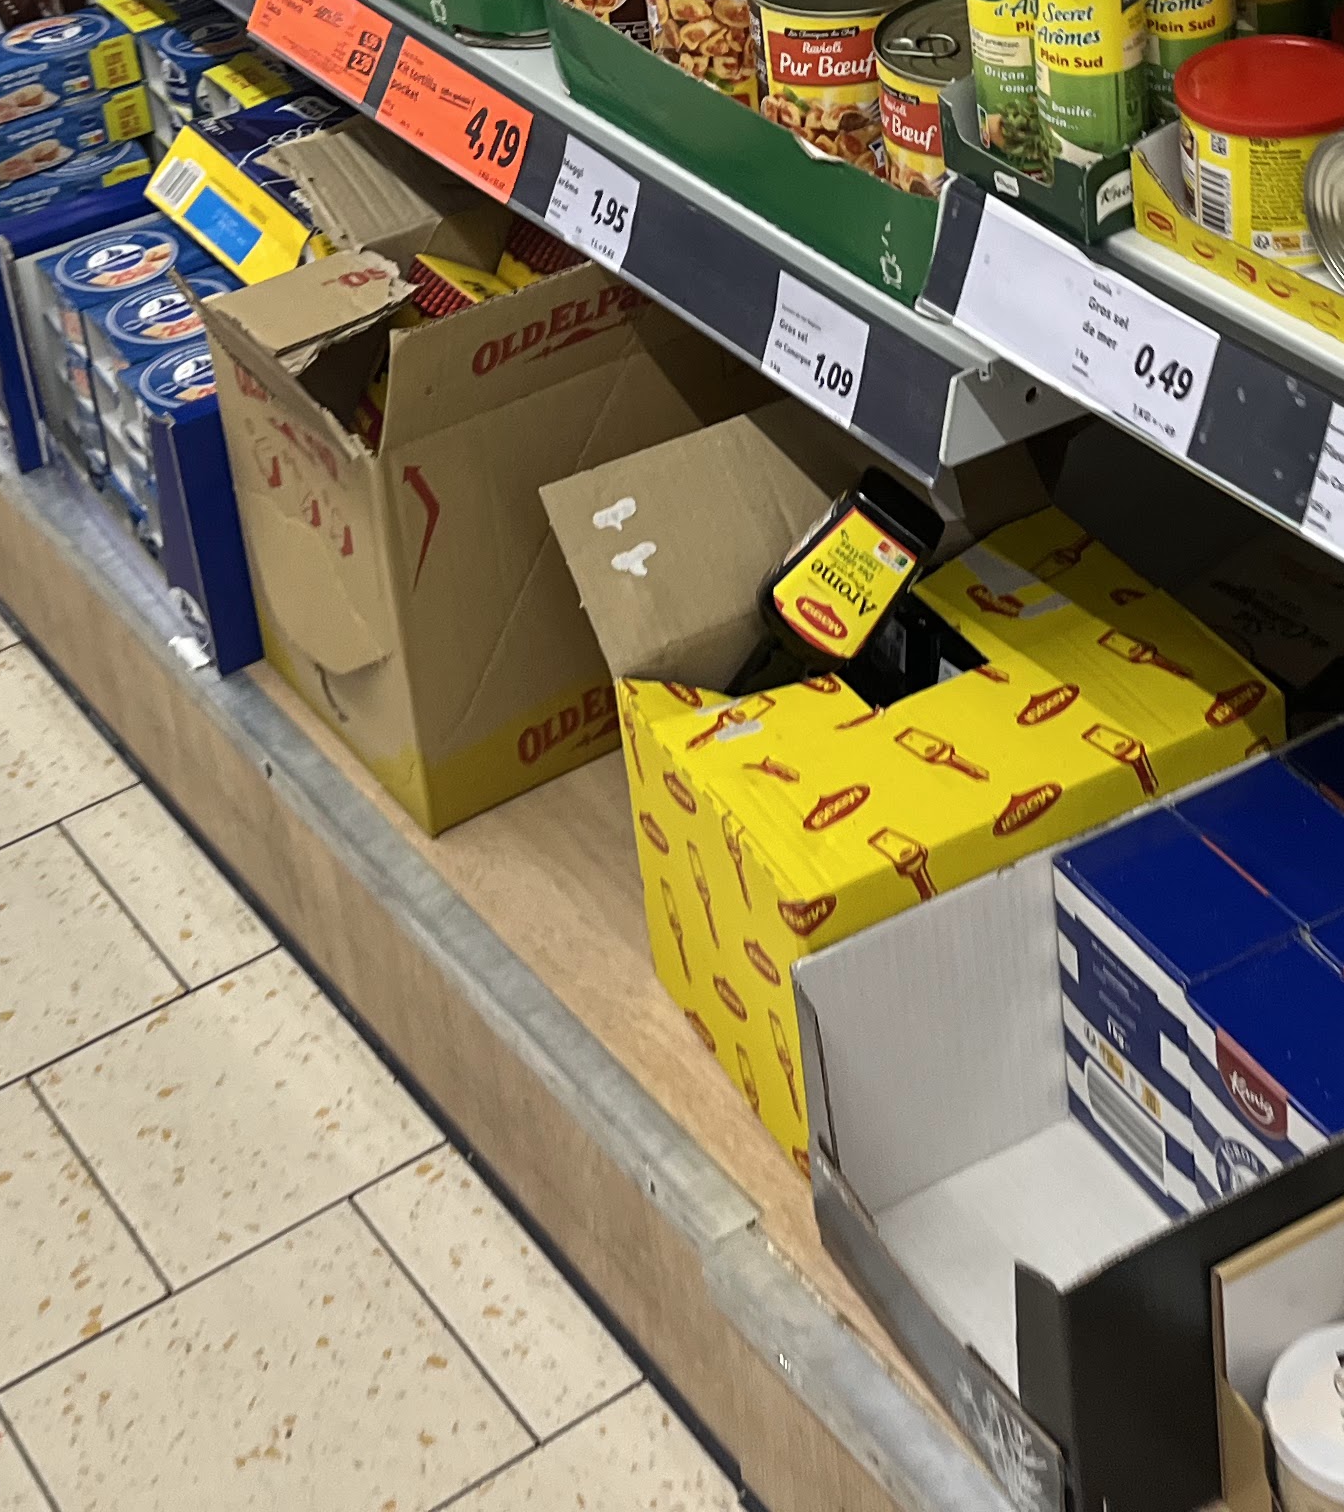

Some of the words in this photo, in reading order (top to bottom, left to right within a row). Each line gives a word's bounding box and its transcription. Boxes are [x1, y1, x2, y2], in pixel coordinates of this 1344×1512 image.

[1042, 2, 1095, 23] Secret
[1146, 19, 1184, 33] Plein
[1187, 14, 1217, 33] Sud
[802, 39, 843, 55] Ravioli
[1037, 25, 1101, 46] Arômes
[779, 58, 813, 77] Pur
[817, 52, 877, 78] Bœuf
[1040, 49, 1070, 68] Plein
[1073, 54, 1105, 69] Sud
[396, 59, 410, 75] Kit
[409, 69, 438, 93] tortilla
[464, 106, 520, 168] 4,19
[891, 116, 937, 150] Bœuf
[563, 157, 584, 180] Maggi
[591, 189, 629, 234] 1,95
[1088, 296, 1113, 322] Gros
[1113, 311, 1130, 332] sel
[471, 324, 542, 377] OLD
[546, 300, 597, 345] EL
[797, 331, 809, 344] sel
[1082, 320, 1097, 337] de
[1096, 329, 1119, 353] mer
[814, 353, 854, 397] 1,09
[1079, 351, 1090, 367] kg
[1134, 343, 1194, 401] 0,49
[799, 599, 843, 637] Maggi
[517, 710, 584, 767] OLD
